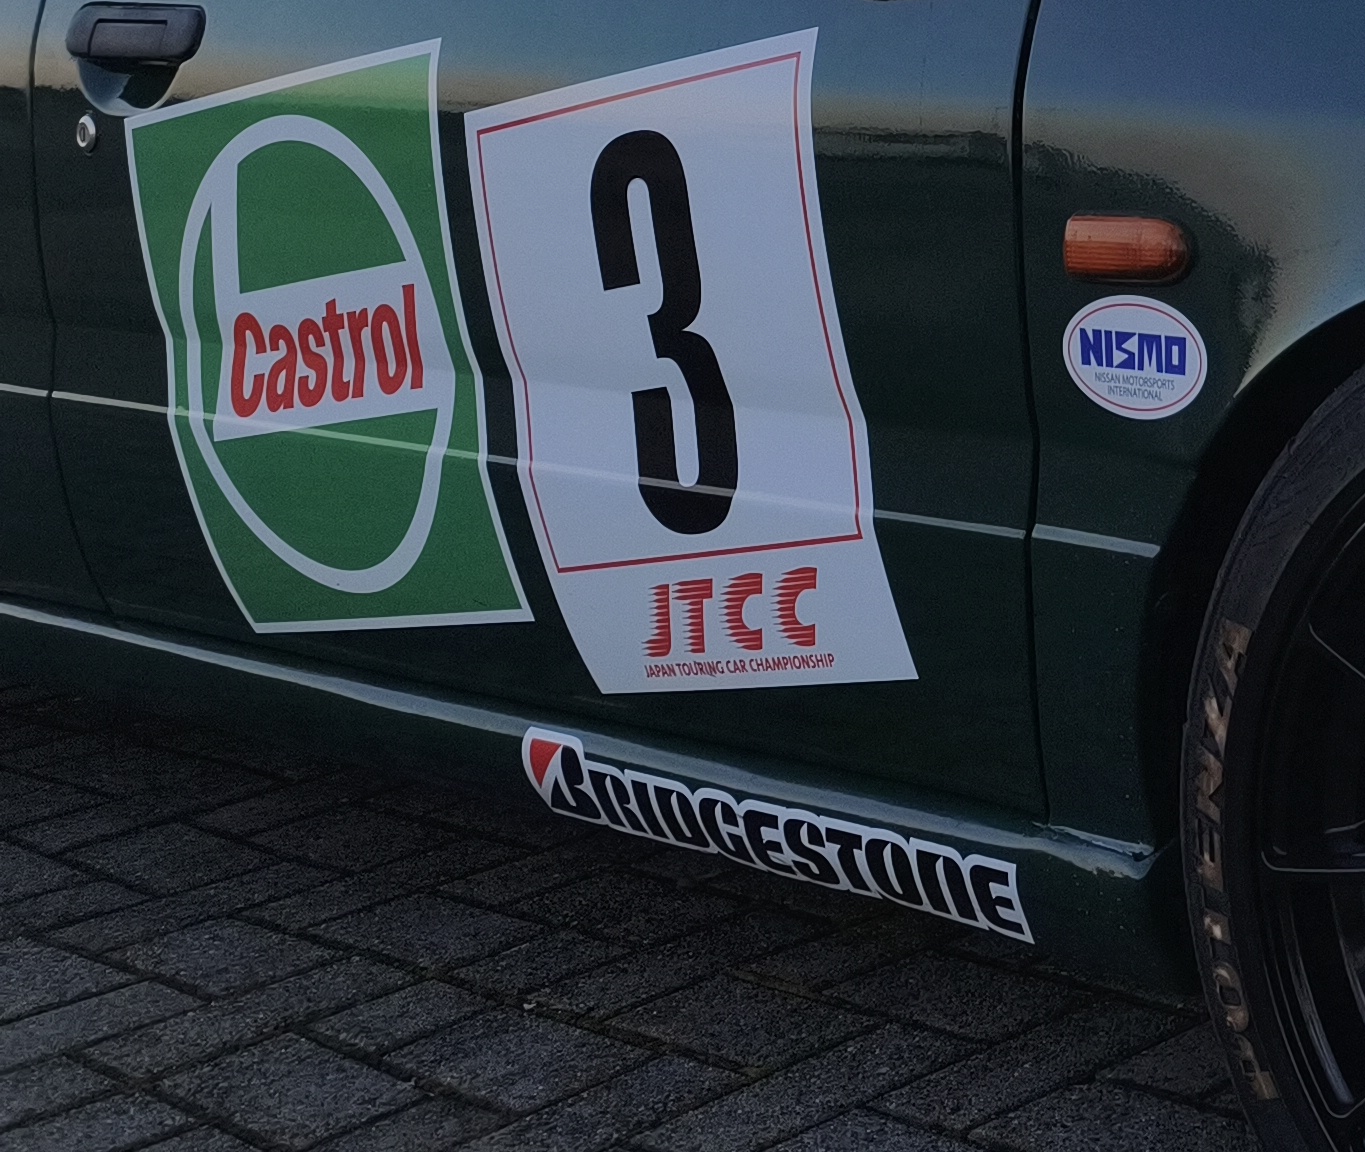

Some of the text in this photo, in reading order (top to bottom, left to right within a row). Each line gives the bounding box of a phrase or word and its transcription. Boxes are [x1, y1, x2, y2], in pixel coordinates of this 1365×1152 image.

[230, 284, 425, 418] Castrol
[589, 129, 740, 536] 3
[1079, 327, 1187, 376] NISMO
[1094, 372, 1176, 391] NISSAN MOTORSPORTS
[1107, 385, 1164, 402] INTERNATIONAL
[641, 567, 818, 657] JTCC
[644, 652, 836, 678] JAPAN TOURING CAR CHAMPIONSHIP
[528, 736, 1029, 938] BRIDGESTONE
